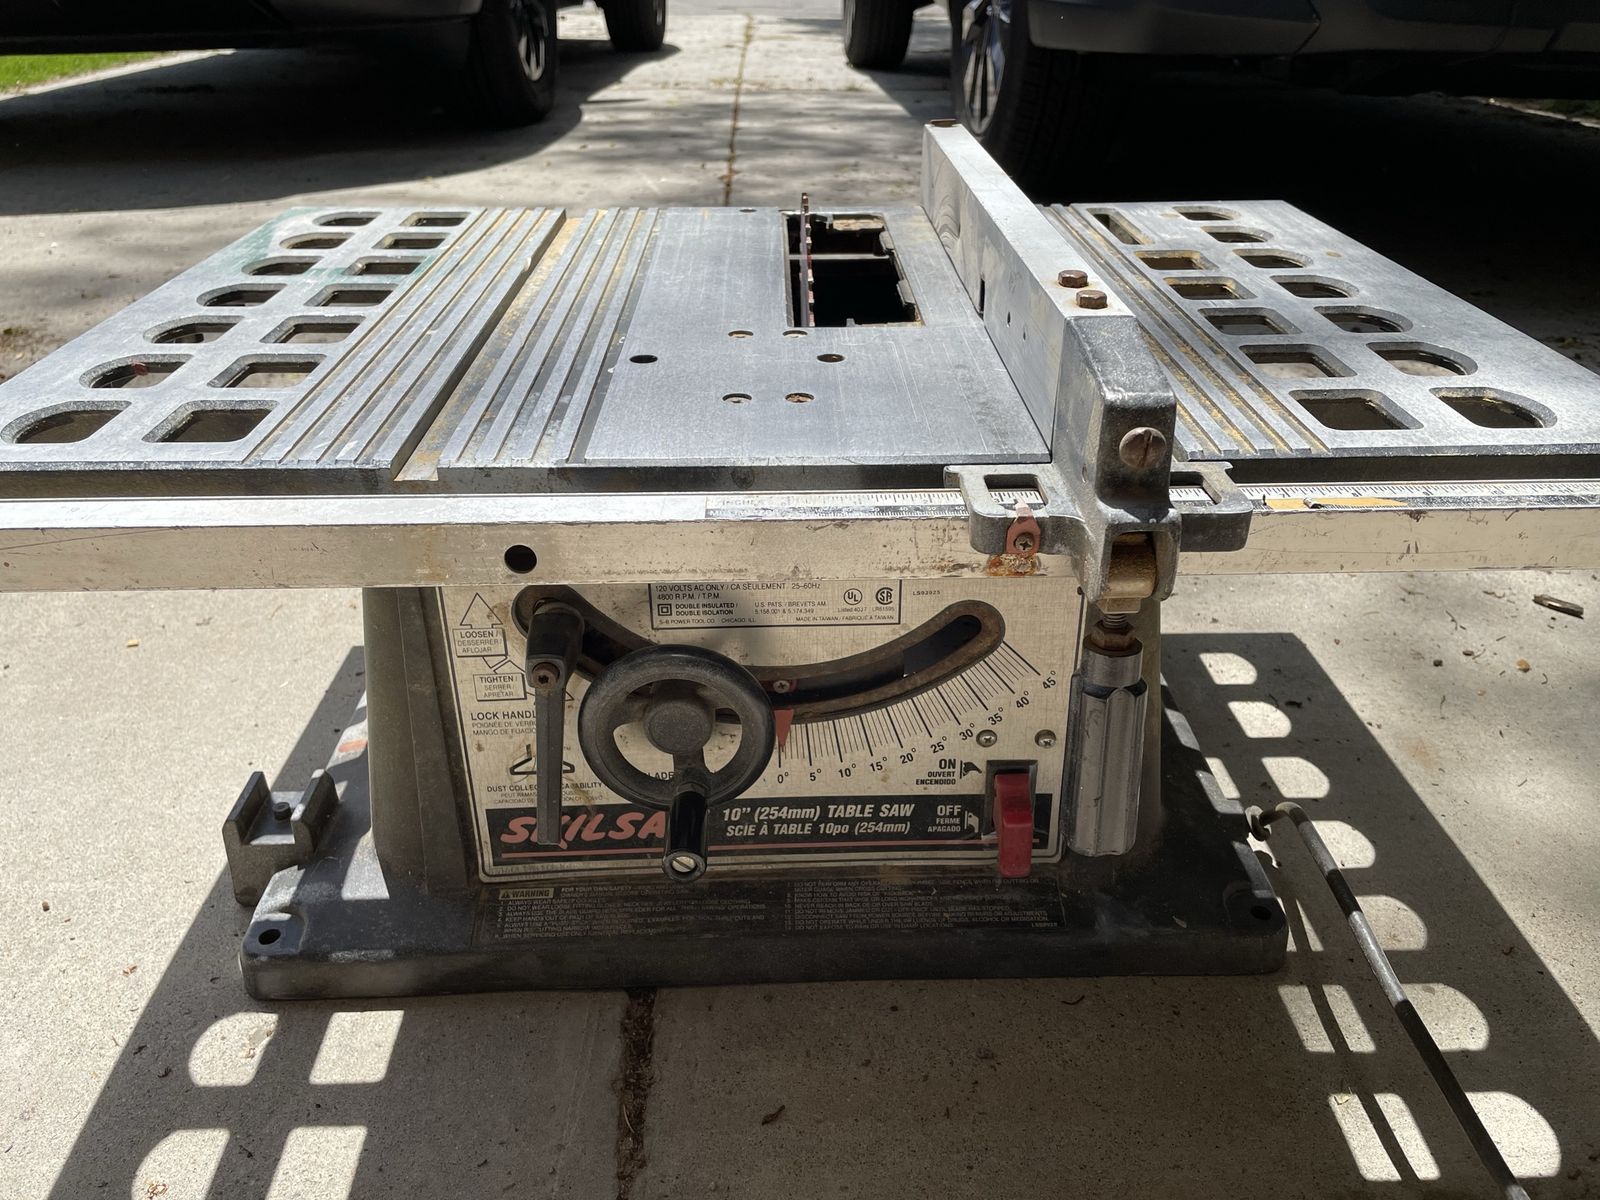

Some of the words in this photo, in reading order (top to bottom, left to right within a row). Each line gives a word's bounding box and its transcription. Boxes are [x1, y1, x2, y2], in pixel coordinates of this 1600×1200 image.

[656, 584, 668, 592] 120
[670, 584, 692, 592] VOLTS
[742, 583, 786, 591] SEULEMENT
[657, 593, 674, 601] 4800
[460, 630, 494, 639] LOOSEN
[457, 639, 499, 647] DESSERRER
[479, 675, 514, 684] TIGHTEN
[1041, 670, 1057, 691] 45°
[1015, 690, 1031, 710] 40°
[470, 711, 500, 721] LOCK
[502, 710, 537, 719] HANDL
[987, 706, 1005, 727] 35°
[958, 722, 976, 742] 30°
[930, 735, 948, 754] 25°
[899, 747, 917, 765] 20°
[869, 756, 888, 773] 15°
[938, 758, 956, 770] ON
[837, 763, 857, 779] 10°
[486, 785, 507, 793] DUST
[754, 805, 821, 823] (254mm)
[827, 804, 875, 818] TABLE
[879, 803, 915, 818] SAW
[936, 805, 962, 816] OFF
[726, 824, 756, 837] SCIE
[759, 821, 769, 836] À
[774, 822, 813, 835] TABLE
[818, 822, 850, 836] 10po
[854, 821, 911, 836] (254mm)
[927, 825, 961, 833] APAGADO
[512, 889, 550, 898] WARNING
